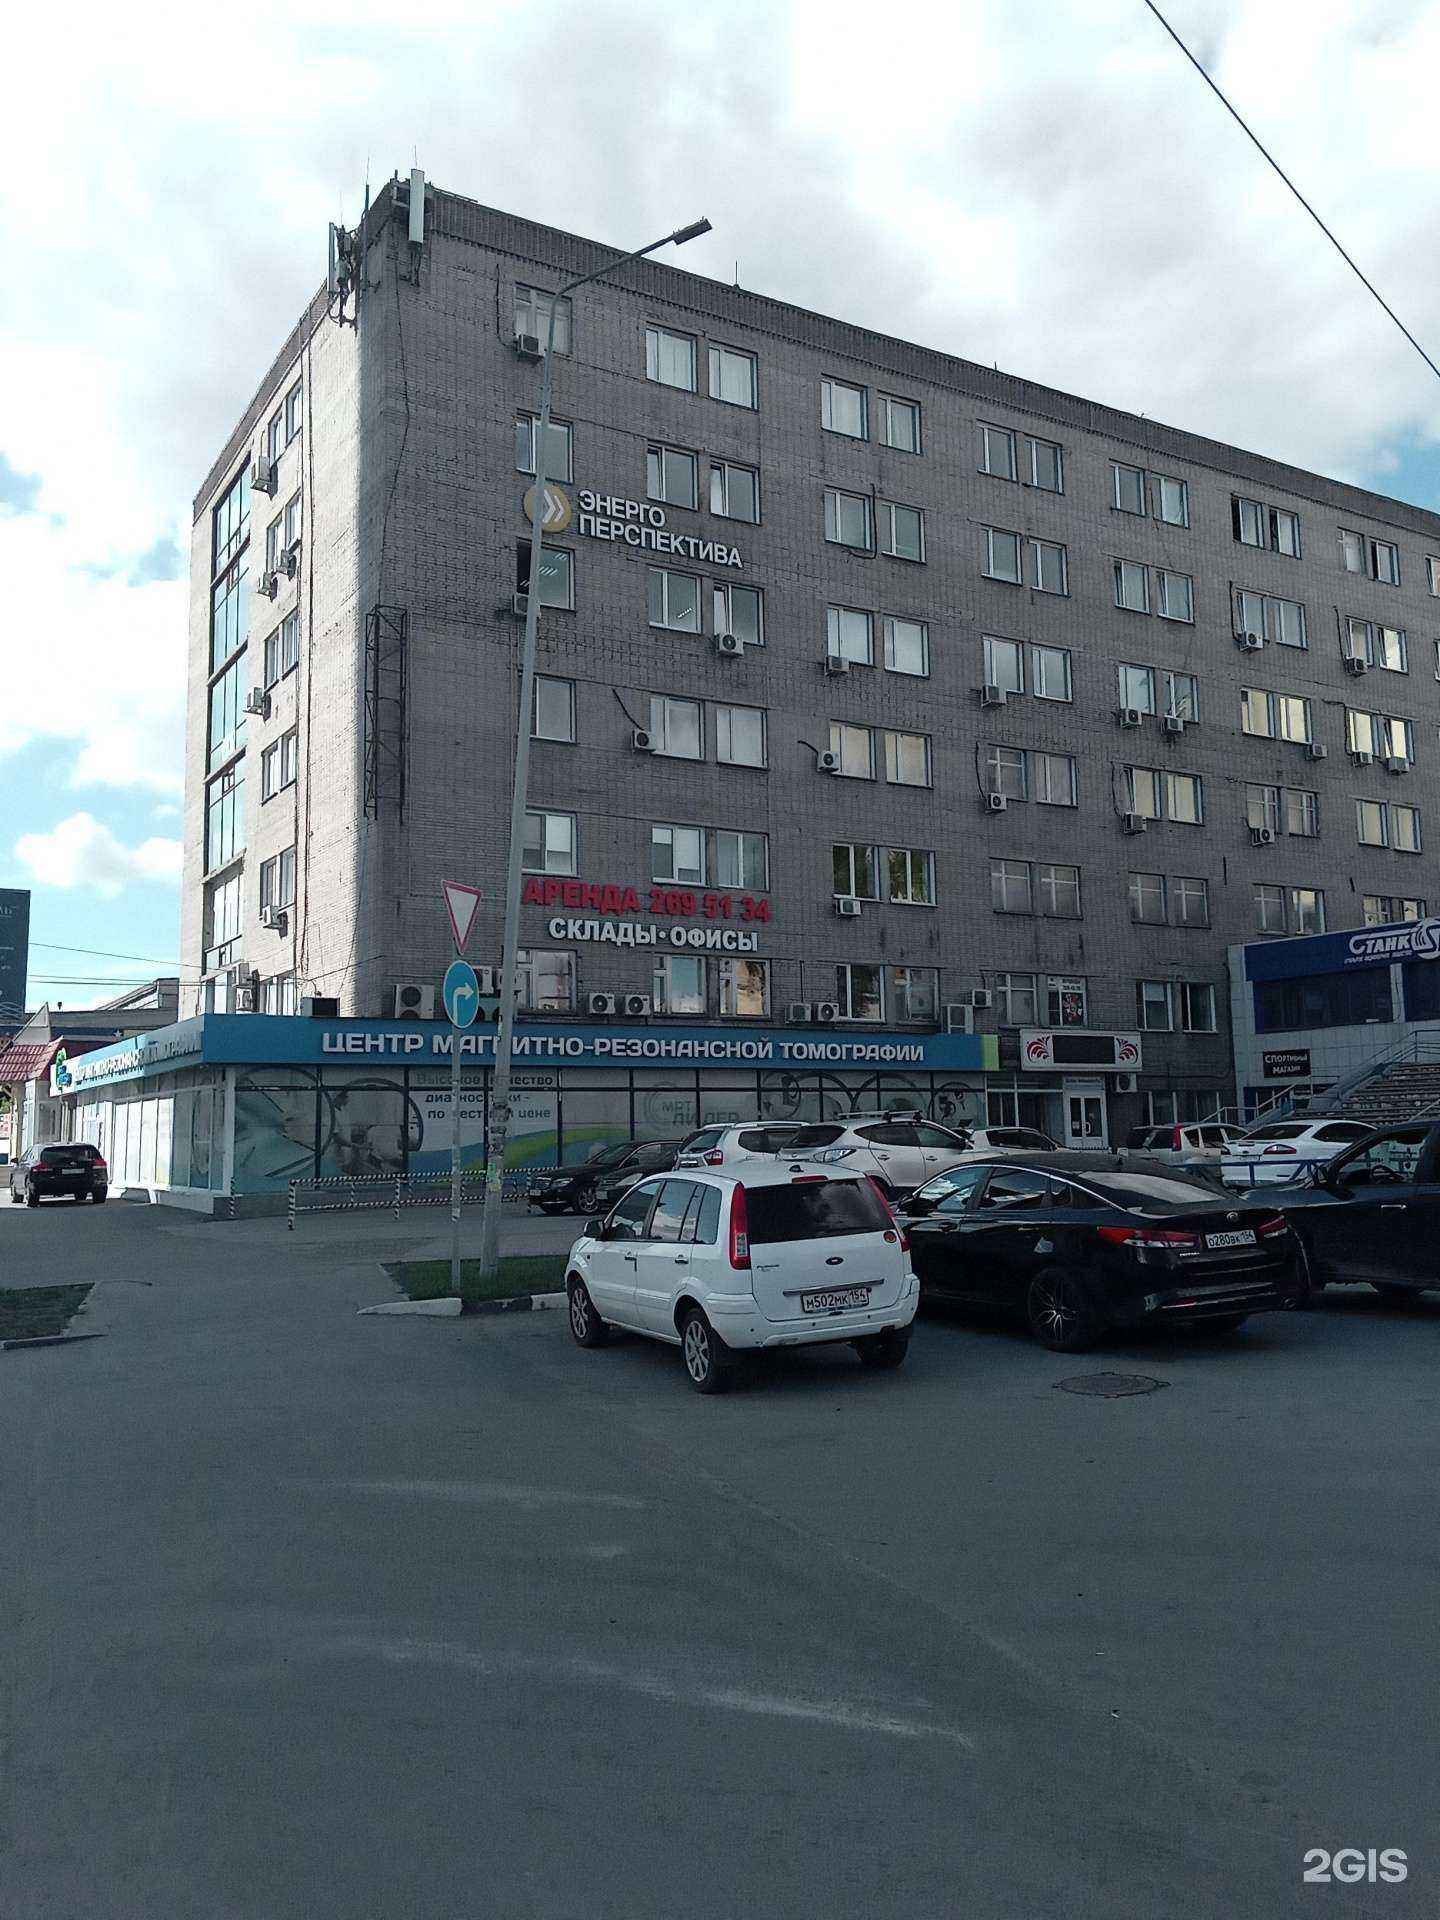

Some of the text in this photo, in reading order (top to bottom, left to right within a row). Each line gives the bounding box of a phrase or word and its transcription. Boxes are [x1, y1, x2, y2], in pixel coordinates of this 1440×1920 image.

[579, 489, 666, 527] ЭНЕРГО
[579, 514, 743, 568] ПЕРСПЕКТИВА
[523, 880, 772, 923] АРЕНДА 269 51 34
[322, 1032, 924, 1062] ЦЕНТР МАГИТНО-РЕЗОНАНСНОЙ ТОМОГРАФИИ
[428, 1110, 446, 1120] по
